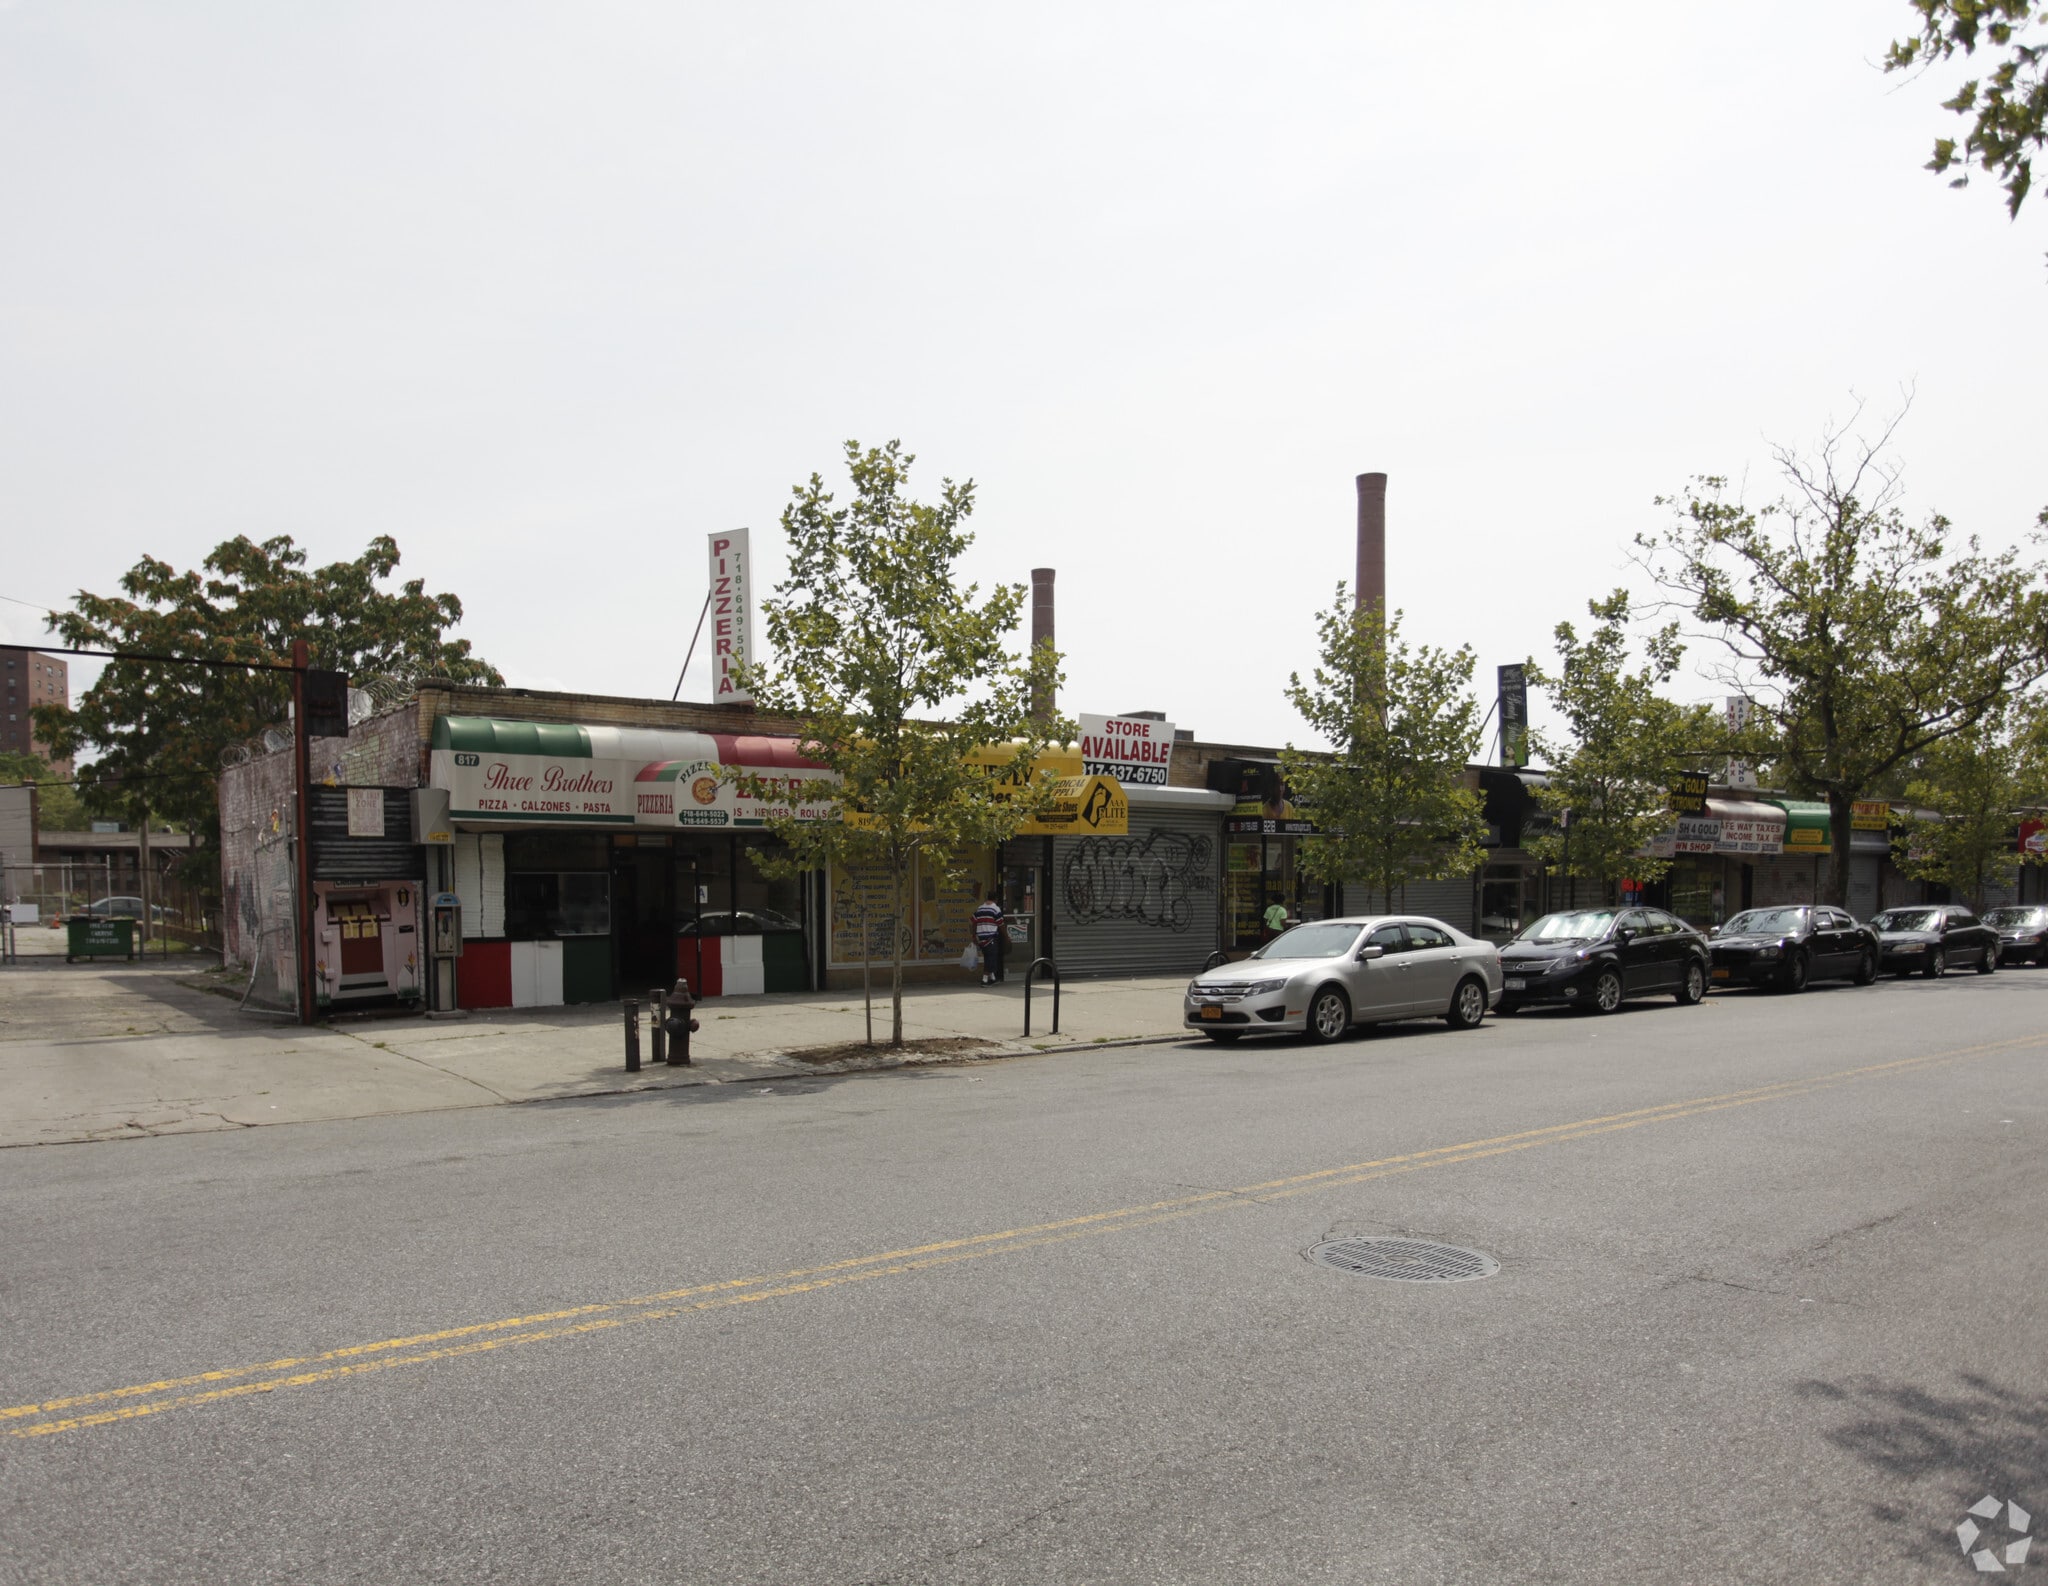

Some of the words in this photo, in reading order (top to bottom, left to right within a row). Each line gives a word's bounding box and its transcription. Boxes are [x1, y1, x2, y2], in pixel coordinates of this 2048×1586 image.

[713, 538, 734, 695] PIZZERIA
[1105, 720, 1150, 738] STORE
[1081, 735, 1170, 763] AVAILABLE
[458, 753, 477, 766] 817
[484, 762, 534, 791] Three
[540, 765, 614, 794] Brothers
[1056, 779, 1086, 788] DICAL
[1054, 788, 1077, 797] PPLY
[1685, 778, 1706, 795] GOLD
[478, 799, 509, 811] PIZZA
[521, 800, 571, 812] CALZONES
[583, 802, 611, 813] PASTA
[637, 793, 674, 815] PIZZERIA
[800, 809, 827, 819] ROLLS
[1679, 822, 1689, 834] SH
[1691, 823, 1696, 833] 4
[1698, 823, 1719, 835] GOLD
[1737, 822, 1753, 832] WAY
[1756, 823, 1781, 833] TAXES
[1726, 831, 1753, 841] INCOME
[1756, 833, 1770, 842] TAX
[1689, 842, 1711, 852] SHOP
